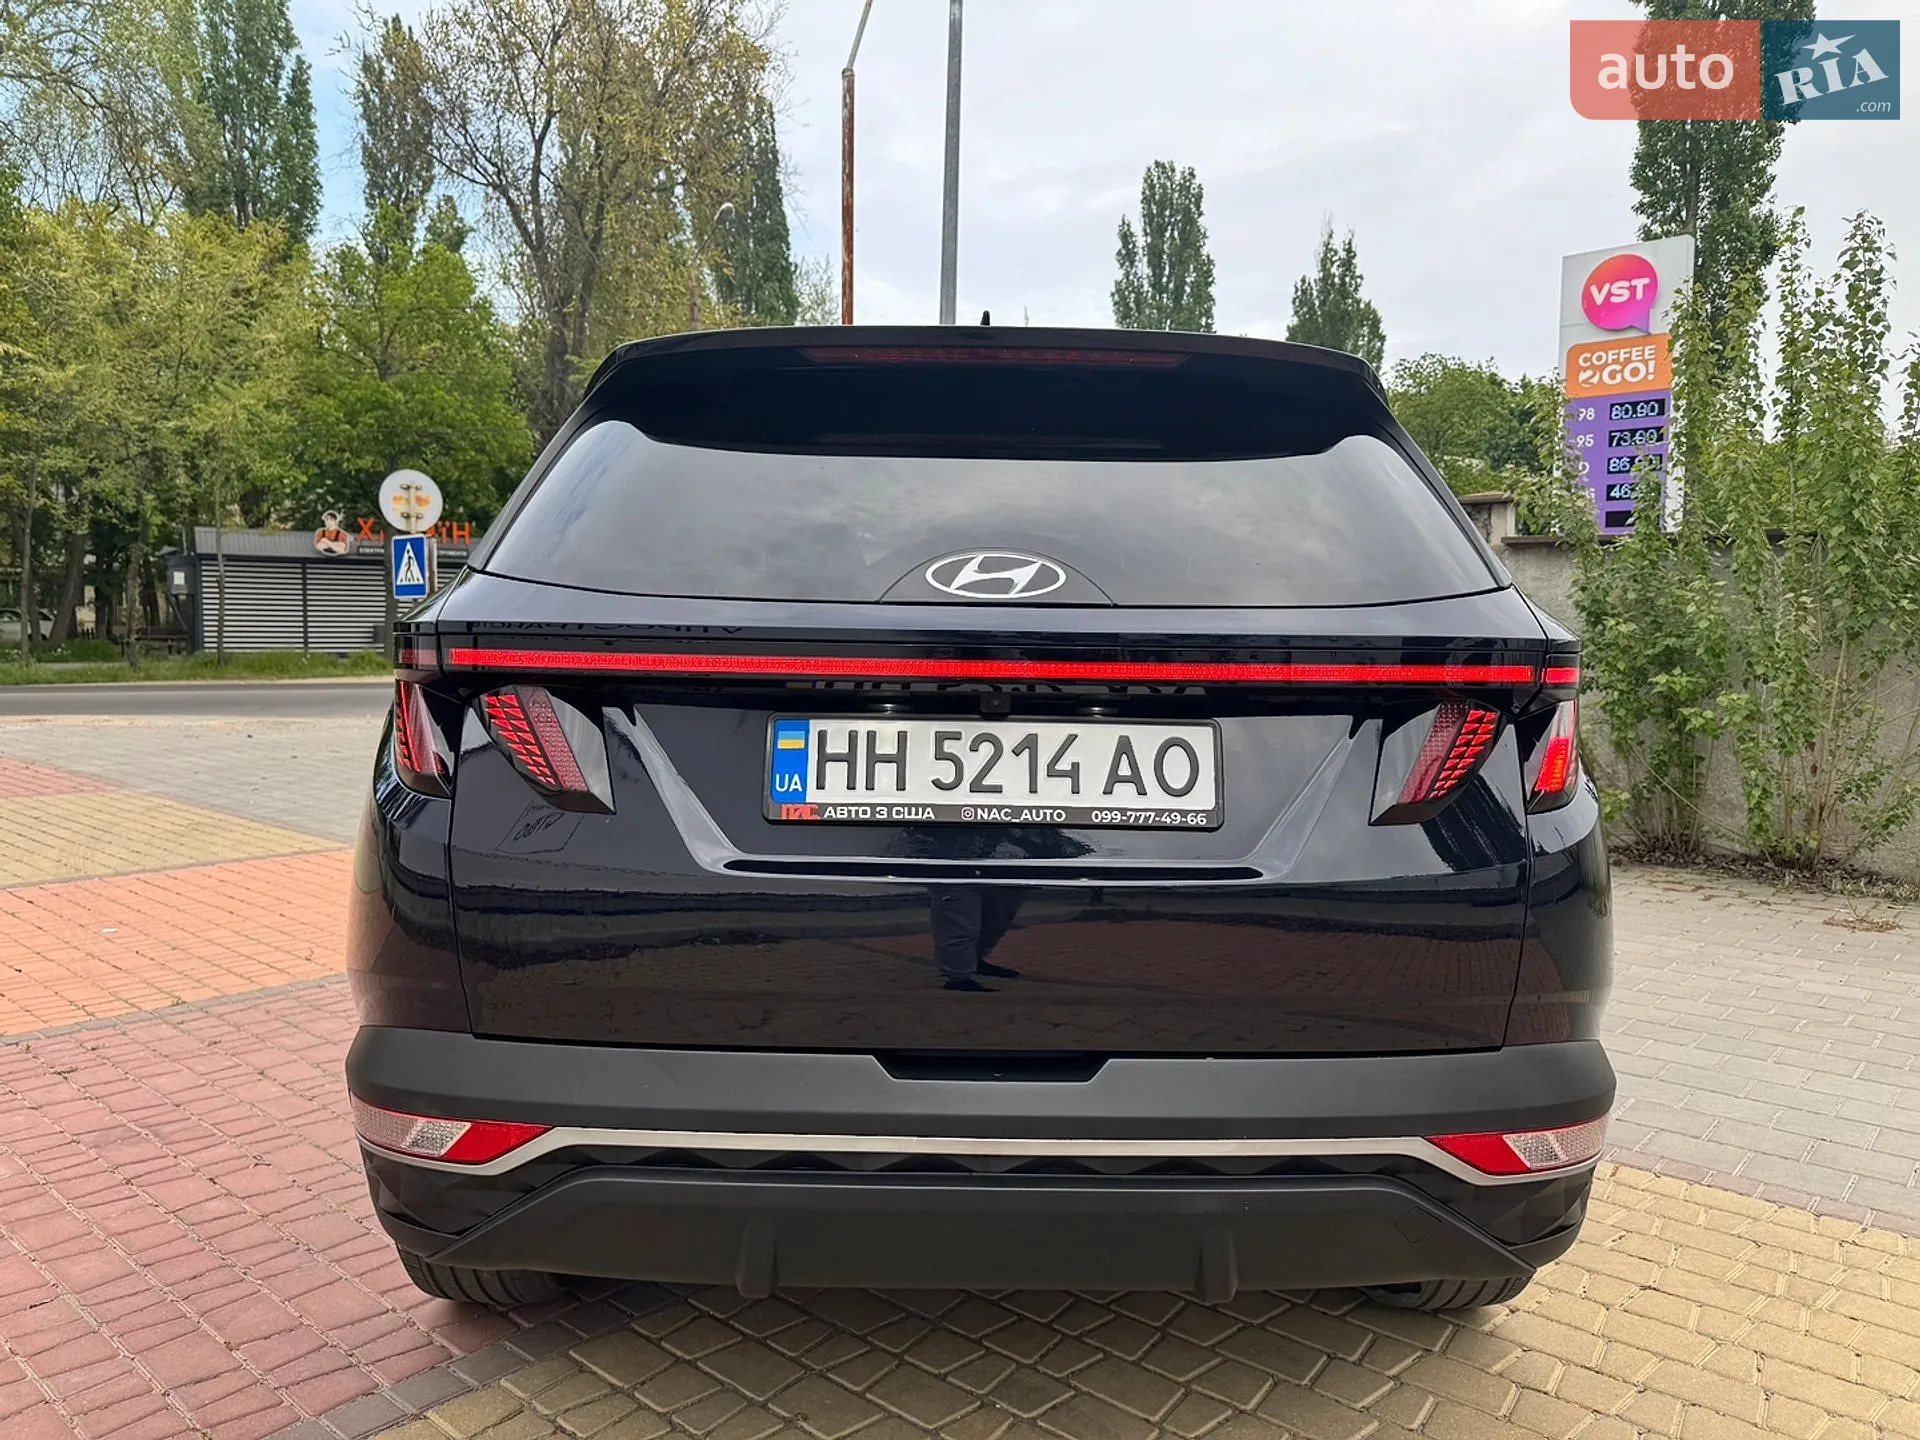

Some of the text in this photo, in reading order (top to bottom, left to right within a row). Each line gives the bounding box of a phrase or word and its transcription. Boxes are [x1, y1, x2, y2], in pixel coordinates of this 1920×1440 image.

[1590, 277, 1650, 306] VST
[1578, 345, 1656, 367] COFFEE
[816, 729, 908, 792] HH
[930, 730, 1080, 795] 5214
[775, 773, 803, 792] UA
[823, 806, 871, 819] АВТО
[892, 806, 935, 820] США
[977, 807, 1067, 822] NAC_AUTO
[1091, 810, 1208, 826] 099-777-49-66
